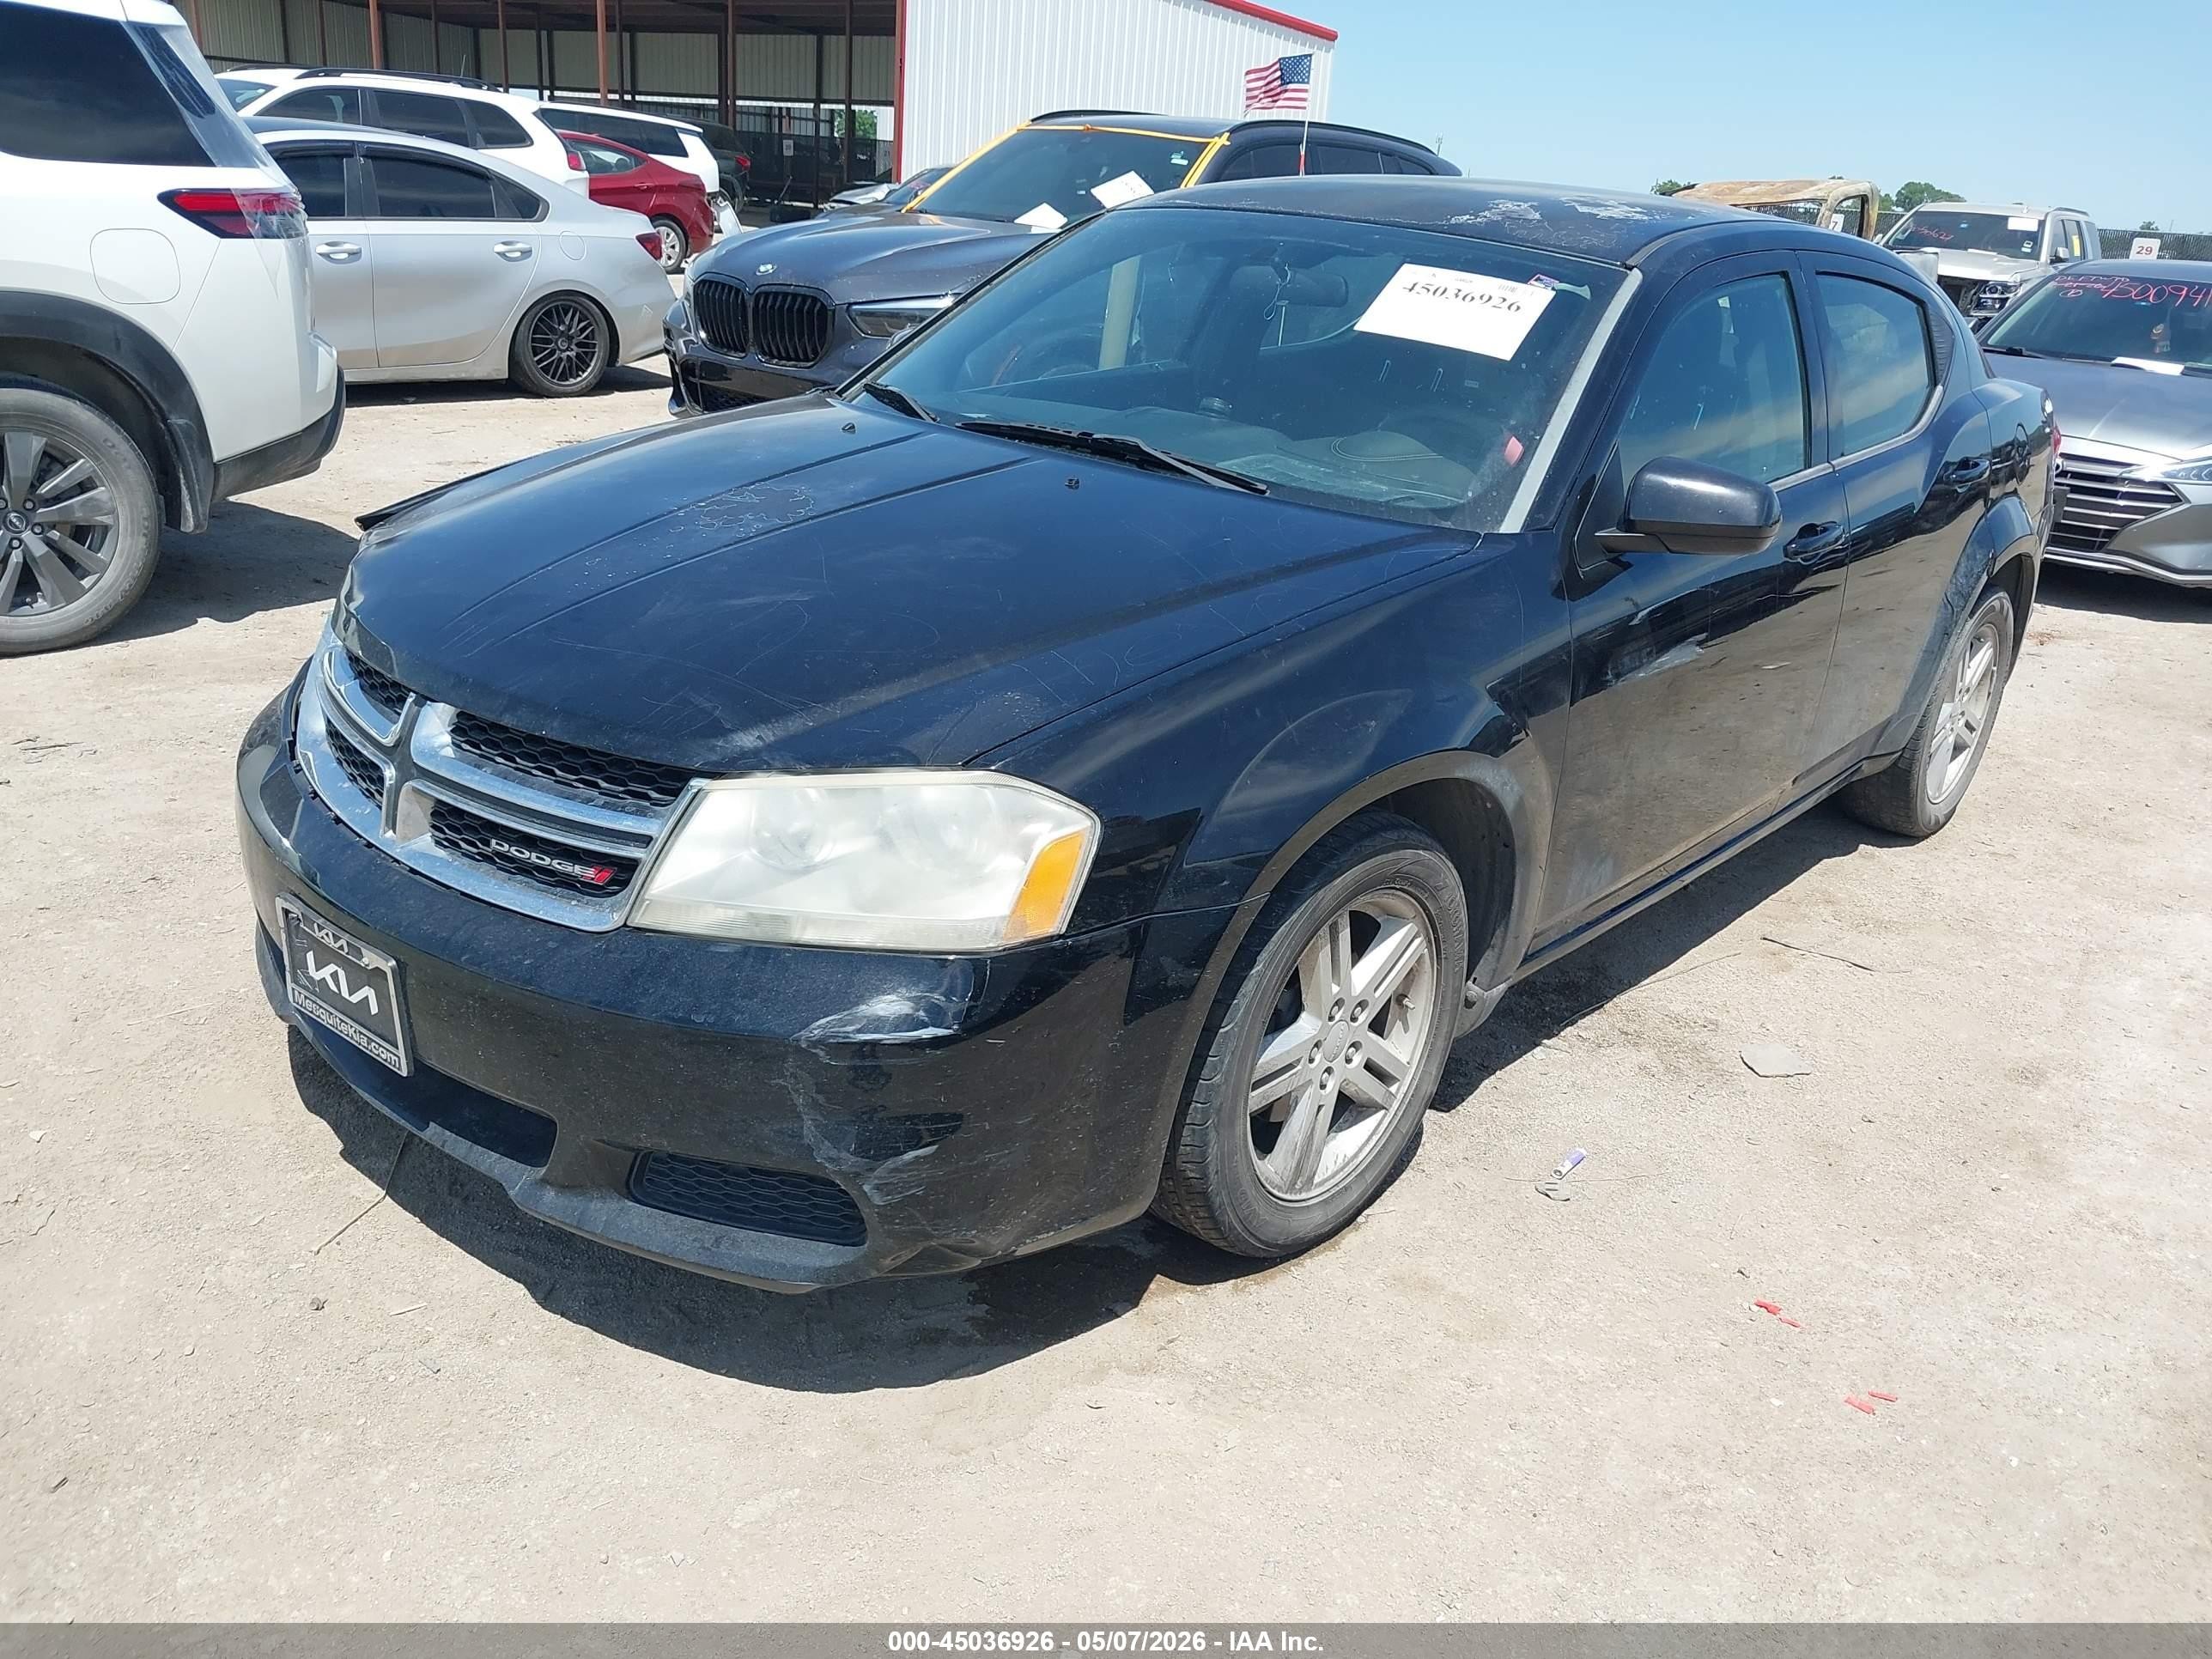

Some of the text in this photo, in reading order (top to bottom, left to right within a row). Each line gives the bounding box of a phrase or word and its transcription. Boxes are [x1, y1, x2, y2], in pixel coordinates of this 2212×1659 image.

[2136, 246, 2154, 255] 29
[1402, 282, 1522, 312] 45036926
[490, 837, 597, 878] DODGE
[306, 950, 379, 1016] KIA
[294, 989, 400, 1069] MesquiteKia.com
